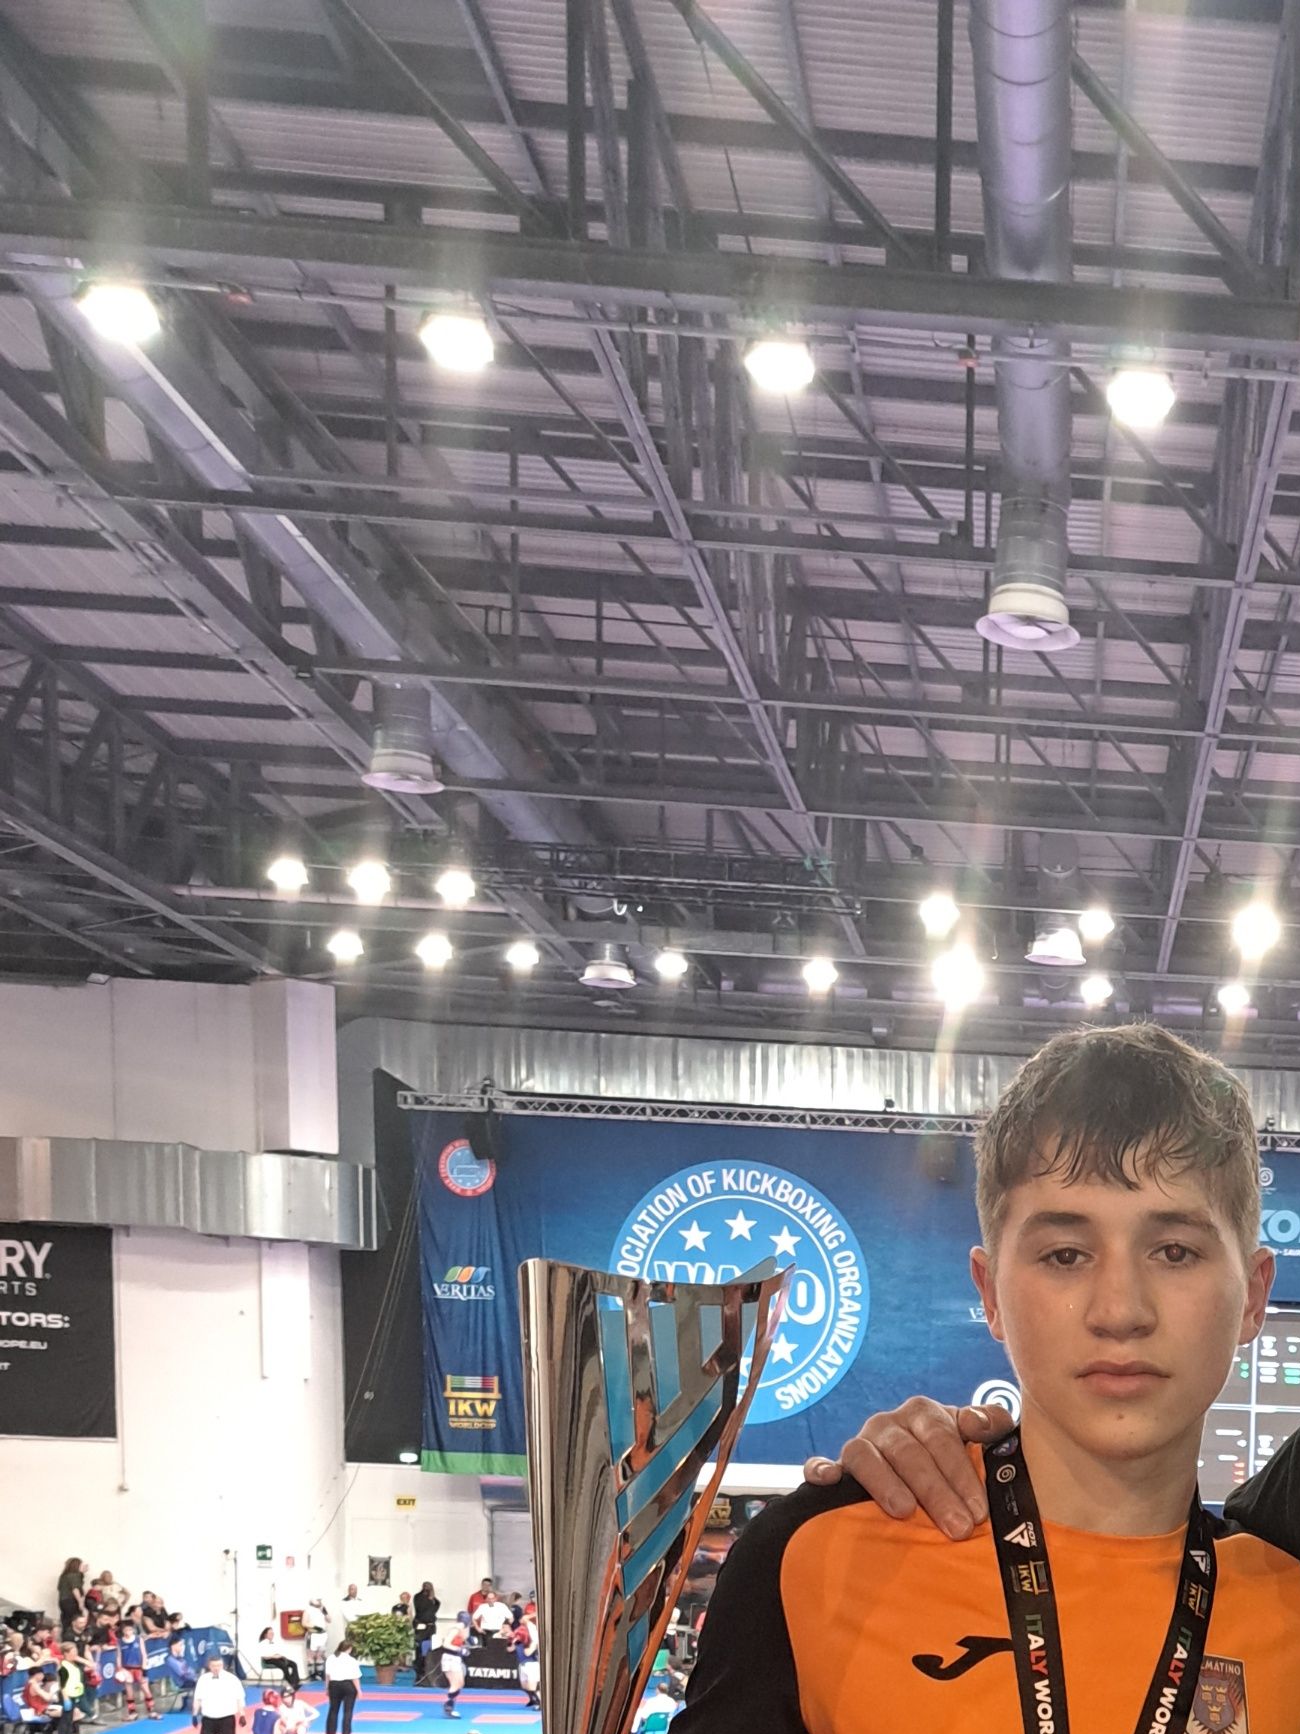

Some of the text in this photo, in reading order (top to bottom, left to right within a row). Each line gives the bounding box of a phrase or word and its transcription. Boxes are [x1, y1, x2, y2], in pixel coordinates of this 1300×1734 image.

[687, 1170, 716, 1198] OF
[721, 1168, 847, 1250] KICKBOXING
[433, 1283, 496, 1300] VERITAS
[775, 1249, 863, 1410] ORGANIZATIONS
[449, 1400, 497, 1417] IKW
[1018, 1564, 1034, 1593] IKW
[1024, 1614, 1048, 1676] ITALY
[1167, 1625, 1193, 1686] ITALY
[467, 1667, 510, 1679] TATAMI
